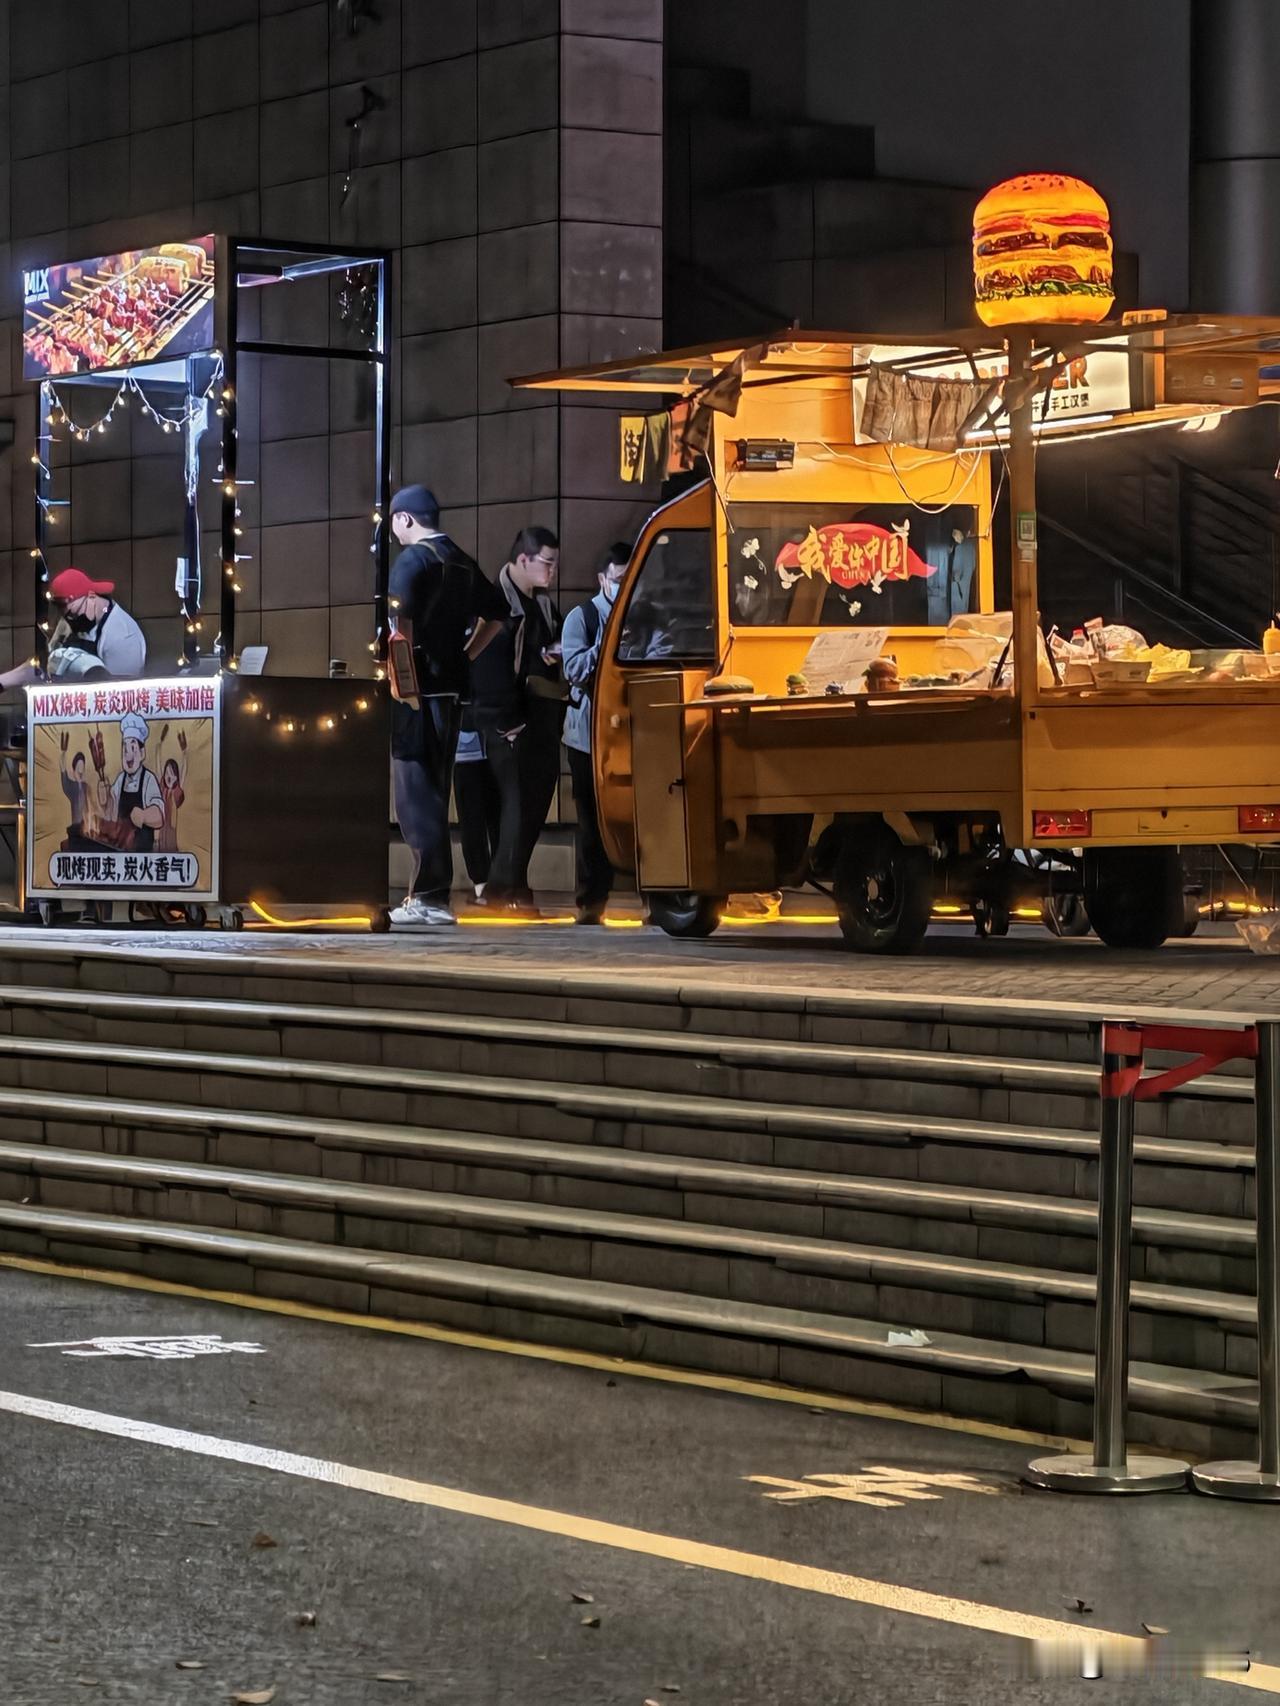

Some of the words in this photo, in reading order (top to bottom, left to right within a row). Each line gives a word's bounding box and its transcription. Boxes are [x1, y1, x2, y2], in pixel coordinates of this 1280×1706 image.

[24, 267, 49, 296] MIX
[797, 523, 909, 584] 我爱你中国
